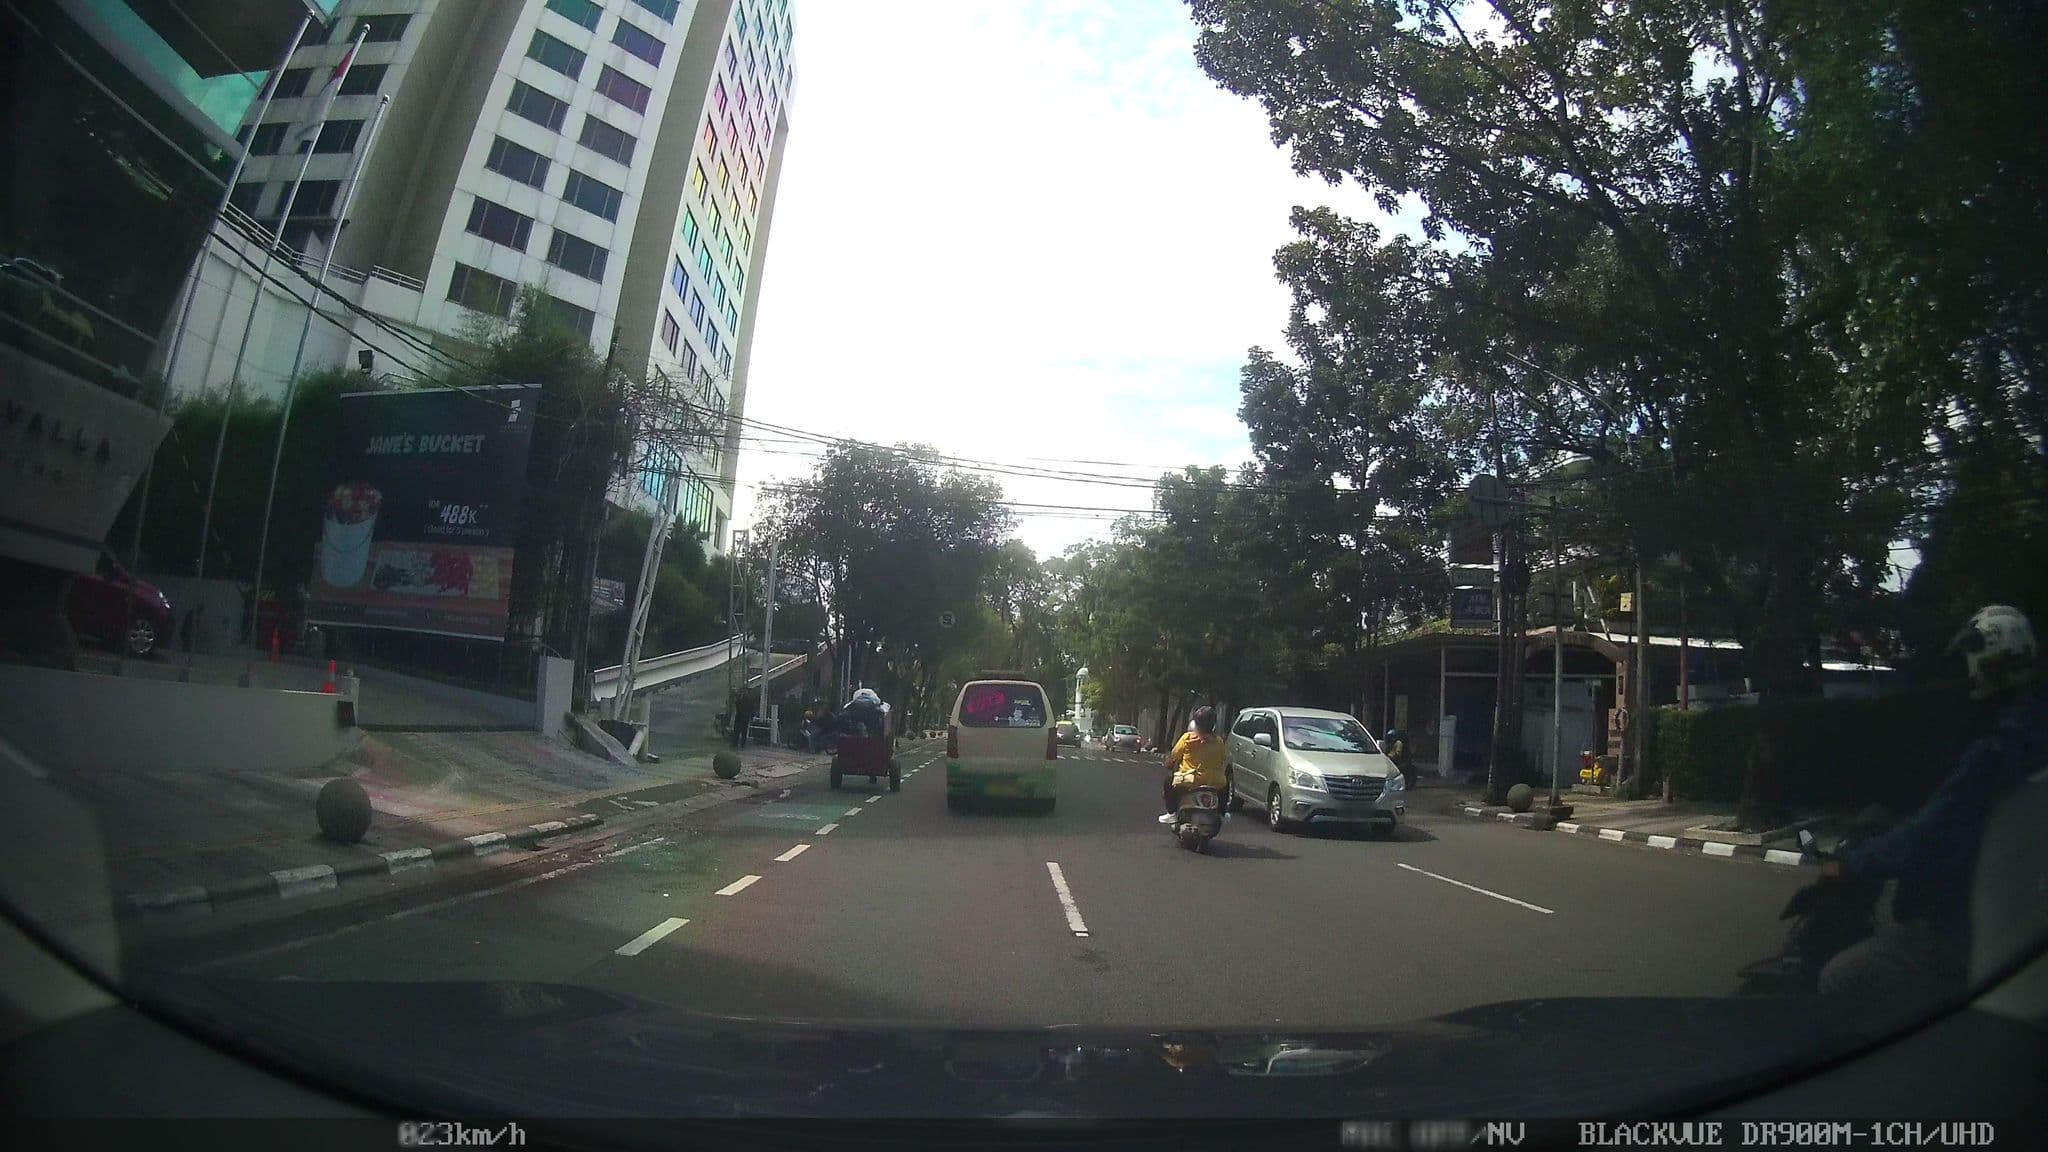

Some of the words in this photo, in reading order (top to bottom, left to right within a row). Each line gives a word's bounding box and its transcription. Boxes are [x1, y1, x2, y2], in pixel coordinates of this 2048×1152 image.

[366, 432, 415, 455] JANE'S
[418, 433, 486, 454] BUCKET
[440, 504, 478, 525] 488K
